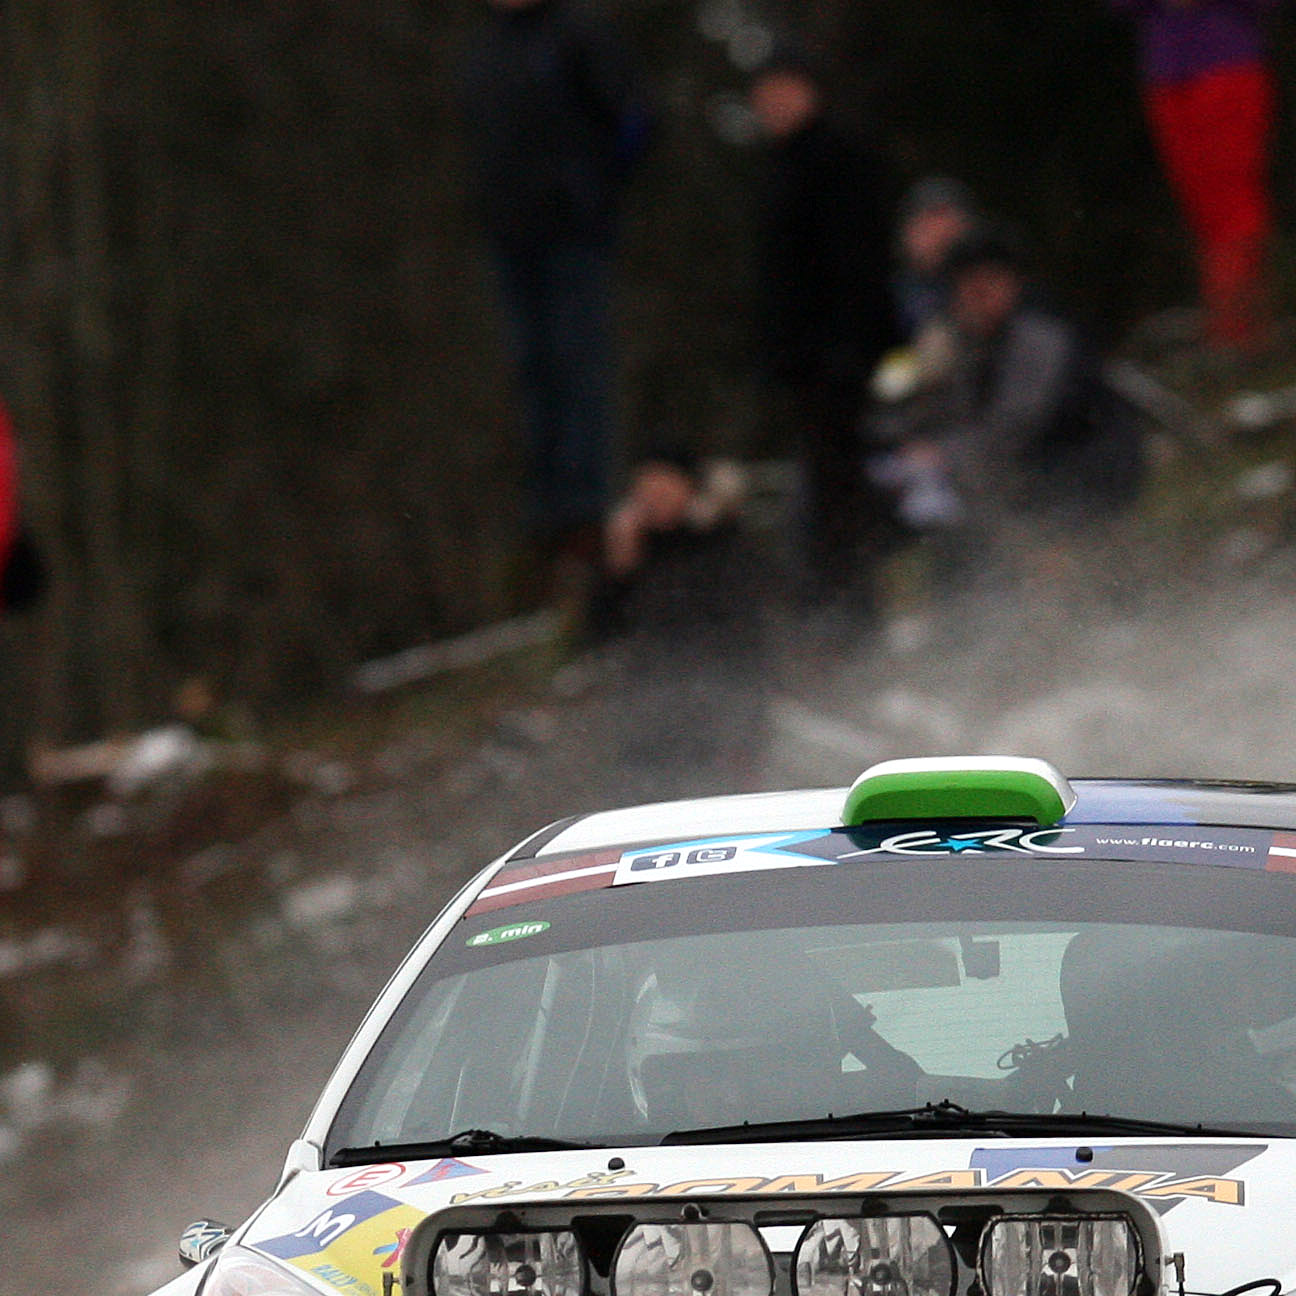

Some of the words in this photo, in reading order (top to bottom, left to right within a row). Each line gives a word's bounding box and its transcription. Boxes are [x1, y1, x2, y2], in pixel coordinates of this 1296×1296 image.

[836, 828, 1085, 860] ERC
[1095, 837, 1256, 854] www.fiaerc.com
[342, 1170, 391, 1189] E
[450, 1170, 636, 1205] visit
